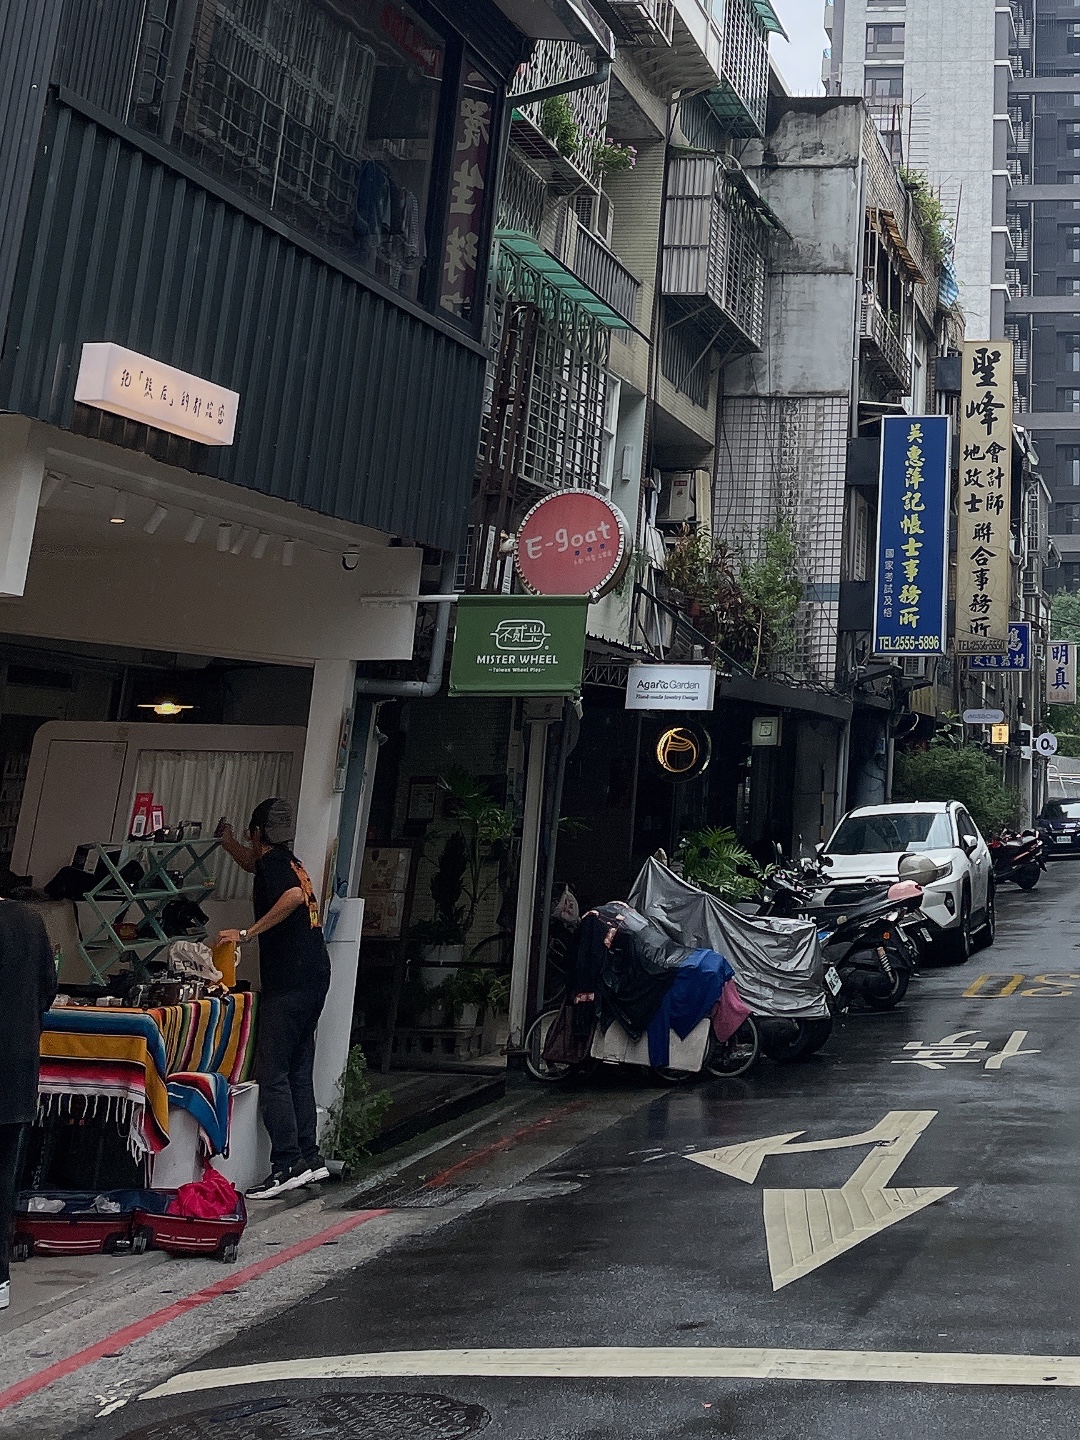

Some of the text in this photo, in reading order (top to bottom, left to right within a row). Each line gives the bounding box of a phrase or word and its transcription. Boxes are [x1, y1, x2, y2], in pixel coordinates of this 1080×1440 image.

[965, 347, 1005, 436] 聖峰
[963, 443, 985, 514] 地政士
[985, 441, 1006, 516] 會計師
[525, 520, 612, 559] E-goat
[968, 522, 998, 638] 聯合事務所
[476, 654, 559, 664] MISTER WHEEL
[1051, 644, 1070, 690] 明真
